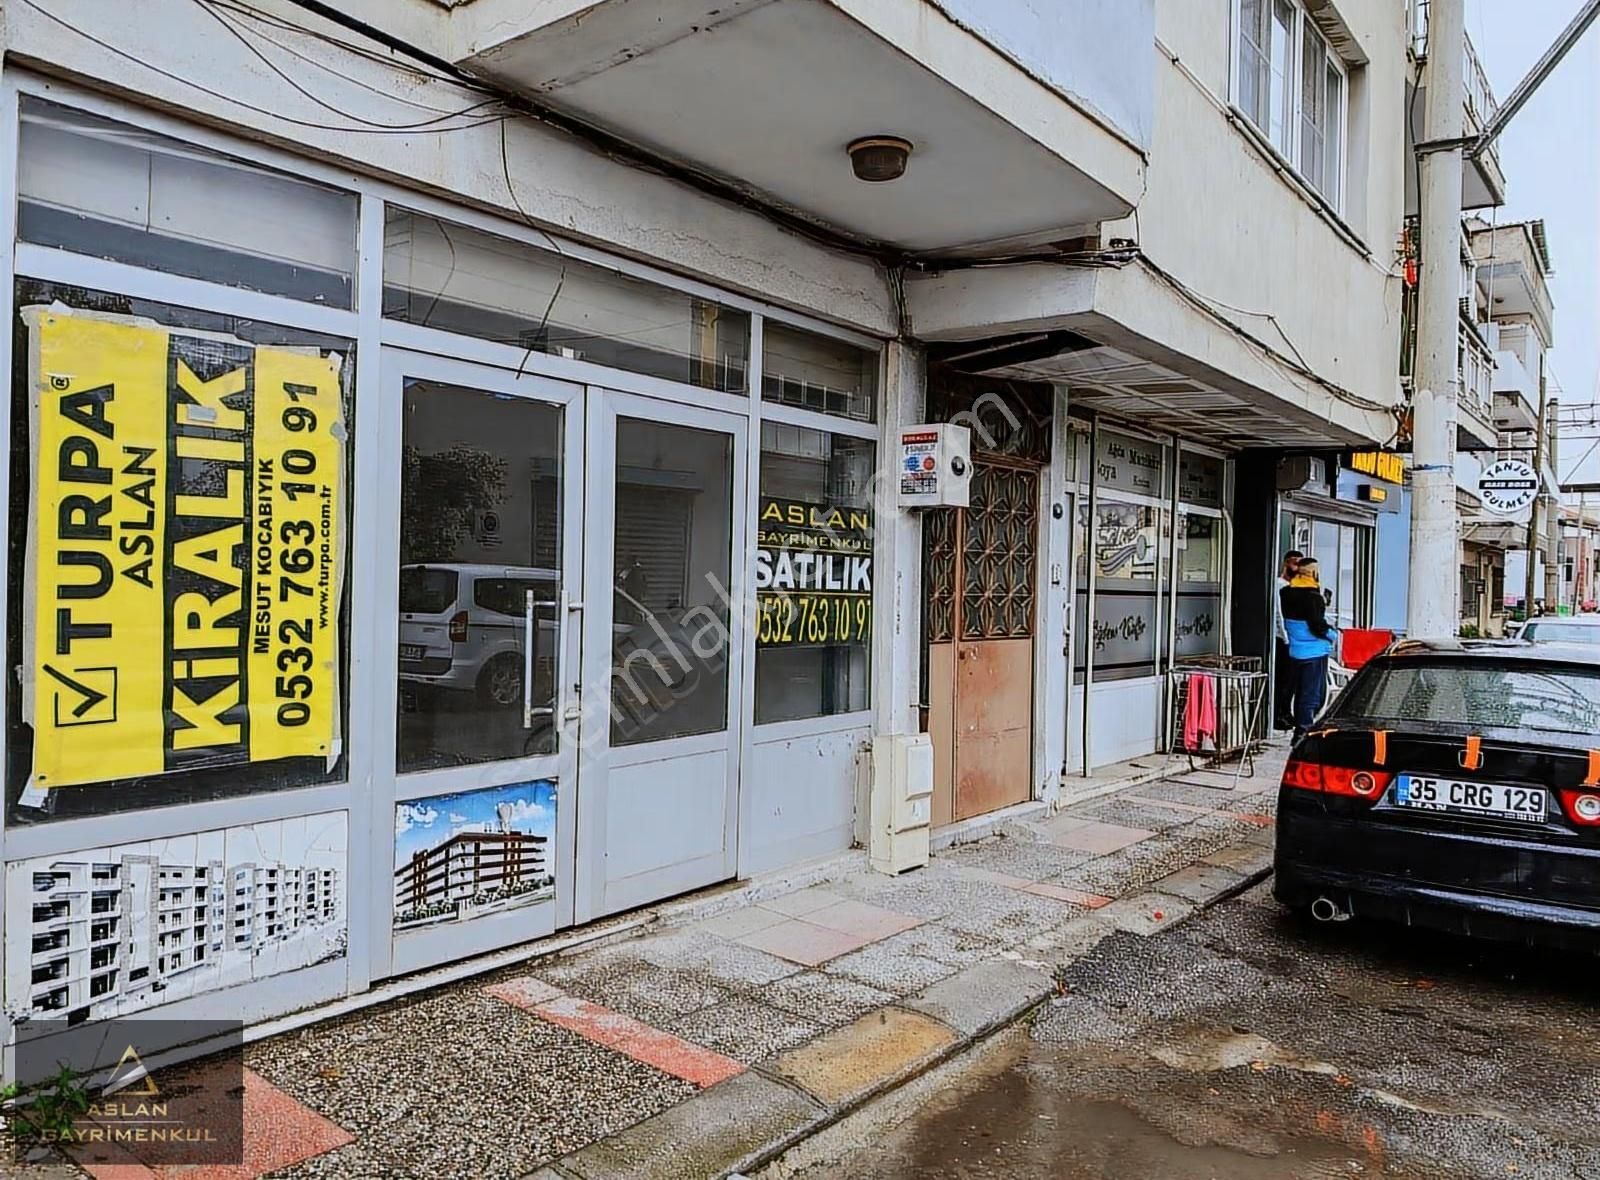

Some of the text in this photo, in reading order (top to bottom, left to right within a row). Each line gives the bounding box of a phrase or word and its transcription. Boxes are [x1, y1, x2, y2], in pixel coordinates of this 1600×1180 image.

[761, 502, 869, 530] ASLAN
[1486, 462, 1530, 478] TANJU
[57, 383, 115, 655] TURPA
[120, 447, 158, 588] ASLAN
[252, 457, 274, 654] MESUT KOCABIYIK
[276, 381, 318, 728] 0532 763 10 91
[319, 484, 333, 629] www.turpa.com.tr
[756, 549, 871, 591] SATILIK
[798, 597, 829, 642] 763
[834, 598, 850, 641] 10
[1409, 778, 1543, 813] 35 CRG 129
